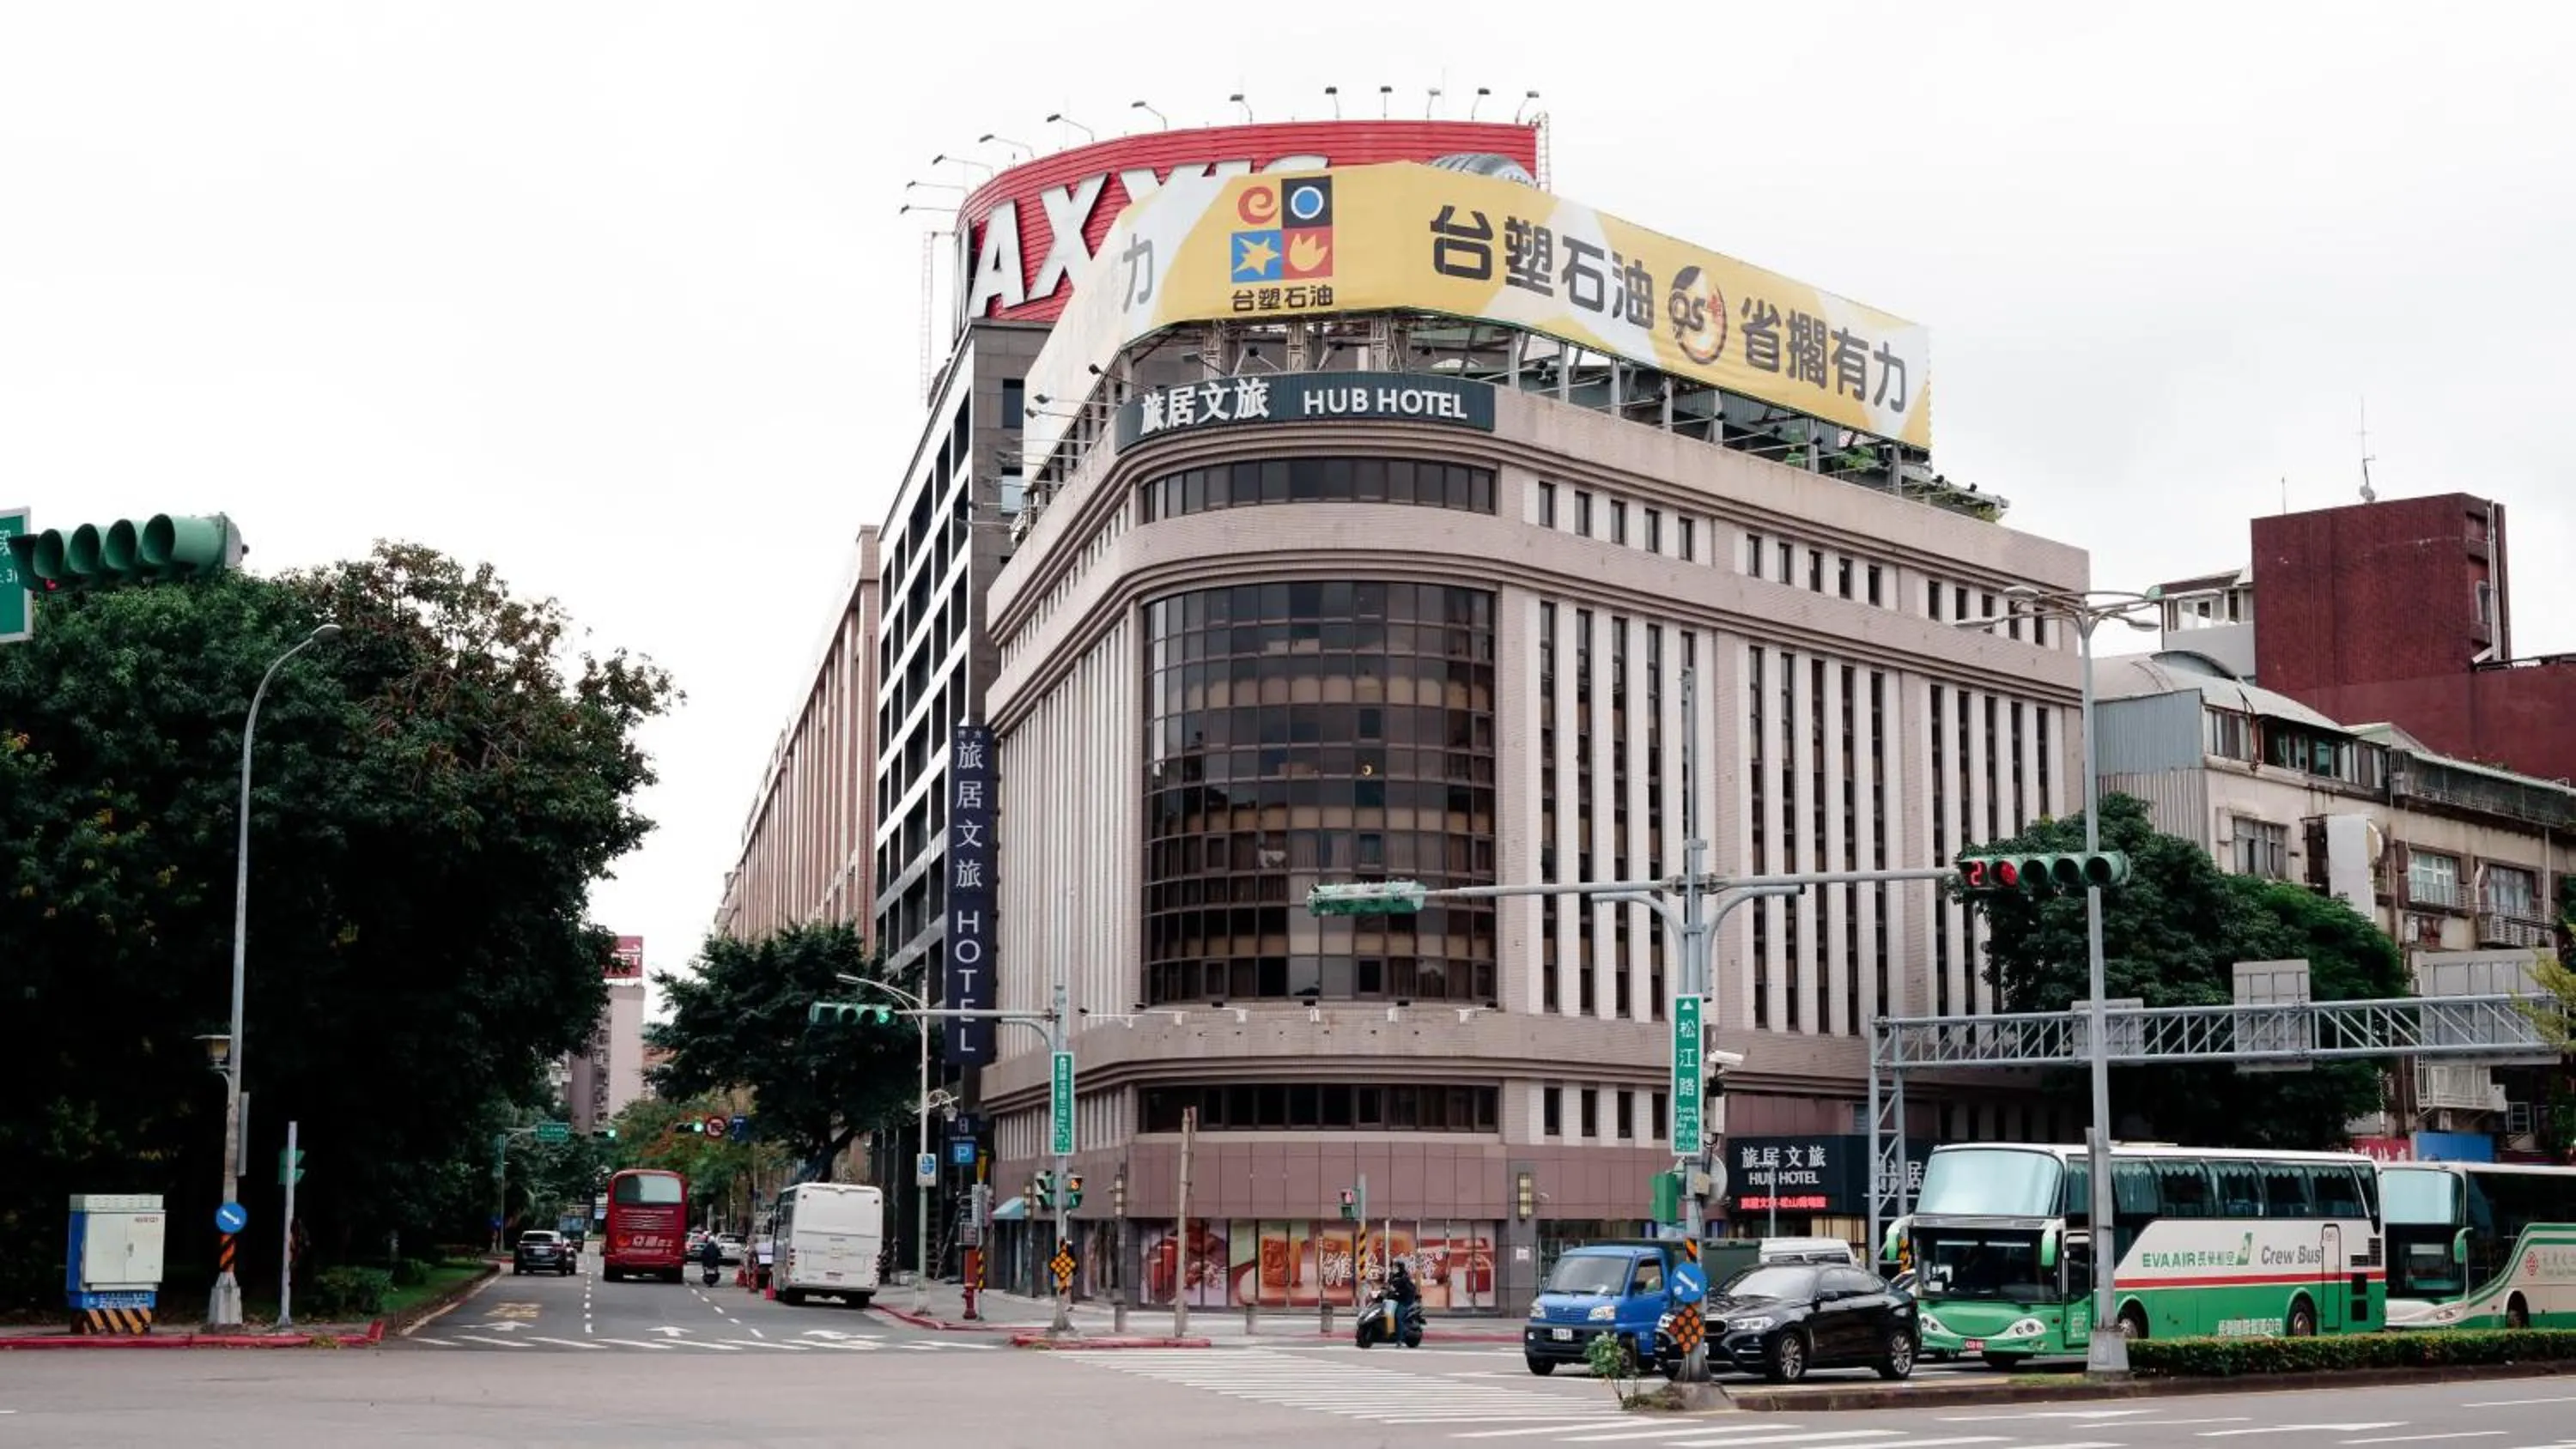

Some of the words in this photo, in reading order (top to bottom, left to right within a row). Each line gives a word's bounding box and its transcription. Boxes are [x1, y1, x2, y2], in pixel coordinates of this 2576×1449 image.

[1122, 233, 1154, 313] 力
[1231, 285, 1334, 312] 台塑石油
[1430, 205, 1655, 330] 台塑石油
[1741, 297, 1908, 413] 省擱有力
[1140, 378, 1271, 435] 旅居文旅
[1303, 388, 1370, 415] HUB
[1376, 388, 1467, 419] HOTEL
[955, 742, 984, 888] 旅居文旅
[954, 910, 981, 1052] HOTEL
[1678, 1020, 1697, 1097] 松江路
[1741, 1144, 1827, 1168] 旅居文旅
[1778, 1170, 1820, 1185] HOTEL
[2261, 1246, 2294, 1265] Crew
[2297, 1245, 2321, 1264] Bus
